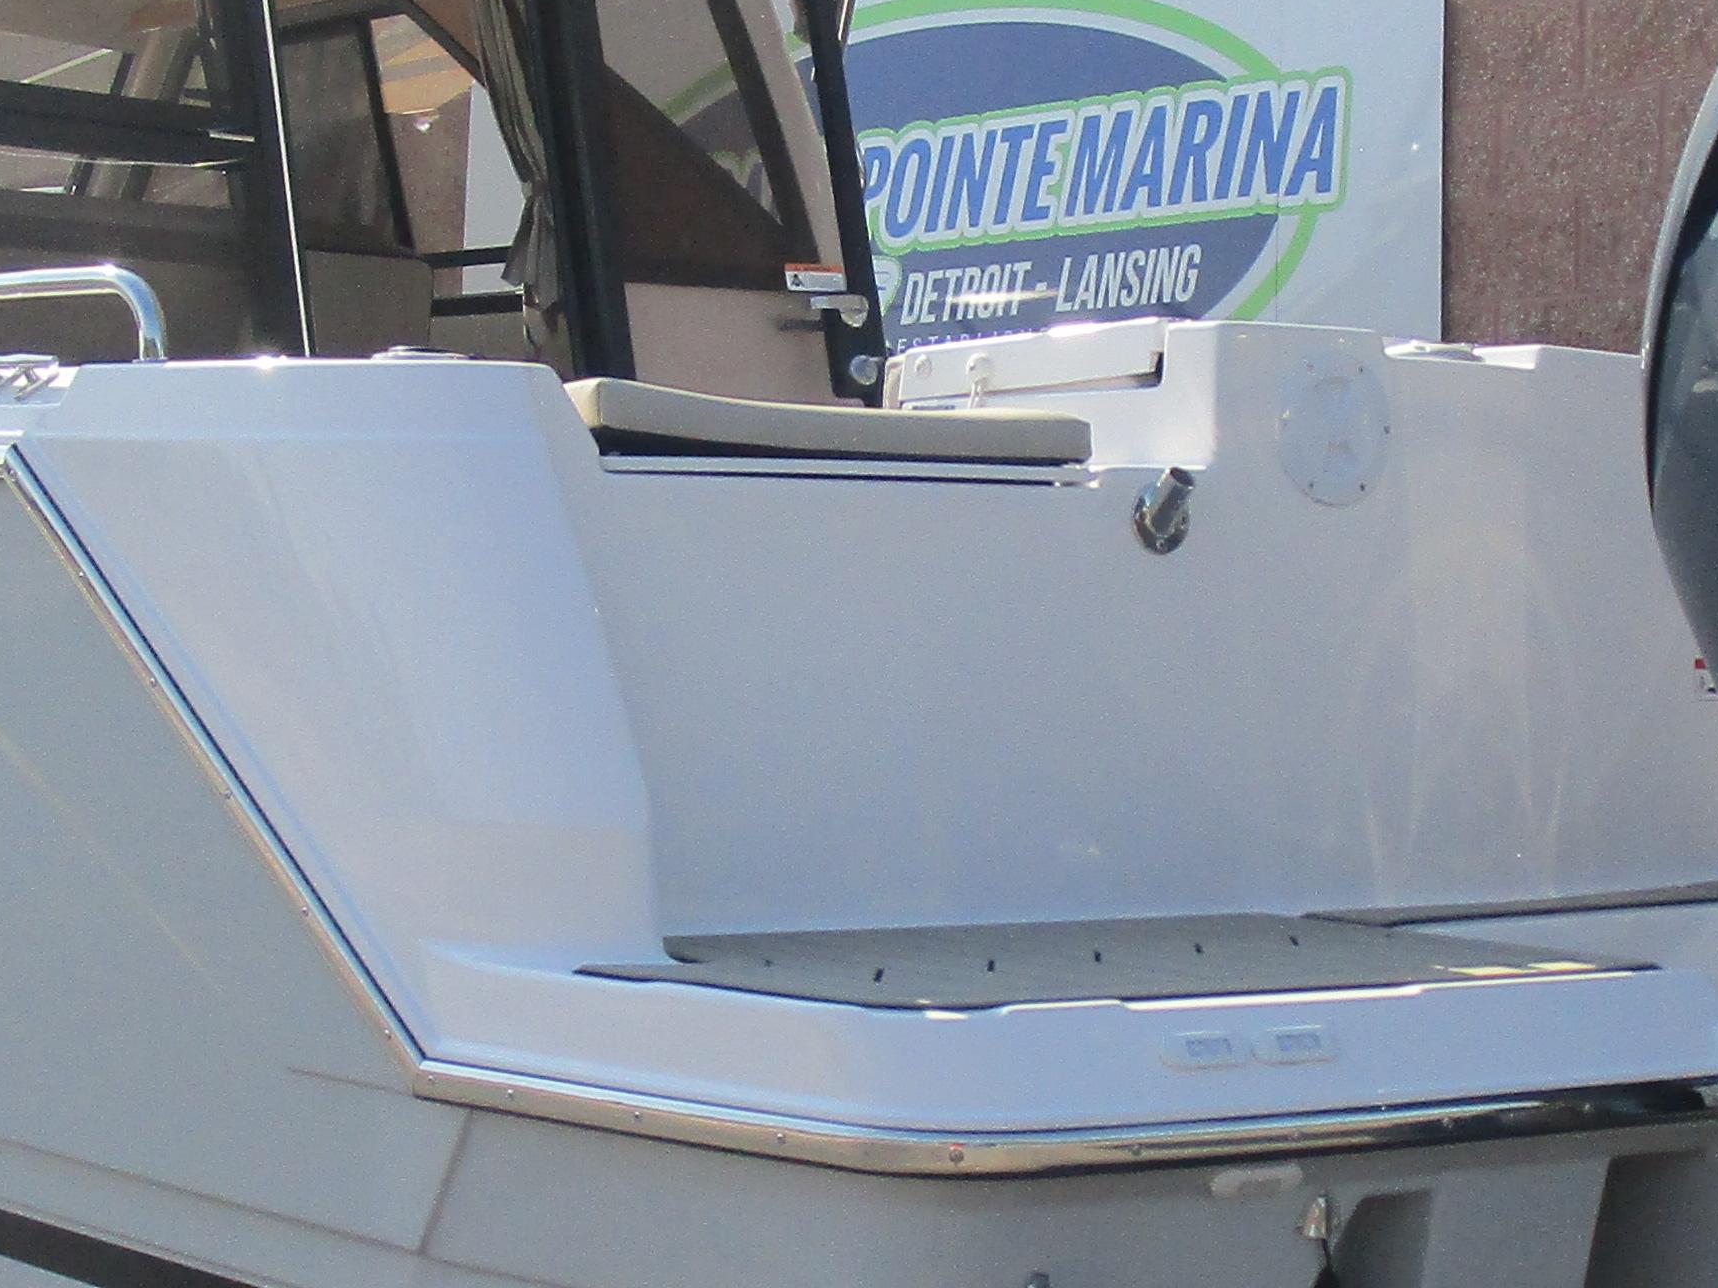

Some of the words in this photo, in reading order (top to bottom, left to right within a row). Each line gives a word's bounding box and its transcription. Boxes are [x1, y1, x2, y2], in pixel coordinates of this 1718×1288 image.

[862, 119, 1069, 239] POINTE
[1063, 84, 1339, 218] MARINA
[899, 261, 1032, 326] DETROIT
[1054, 243, 1201, 313] LANSING
